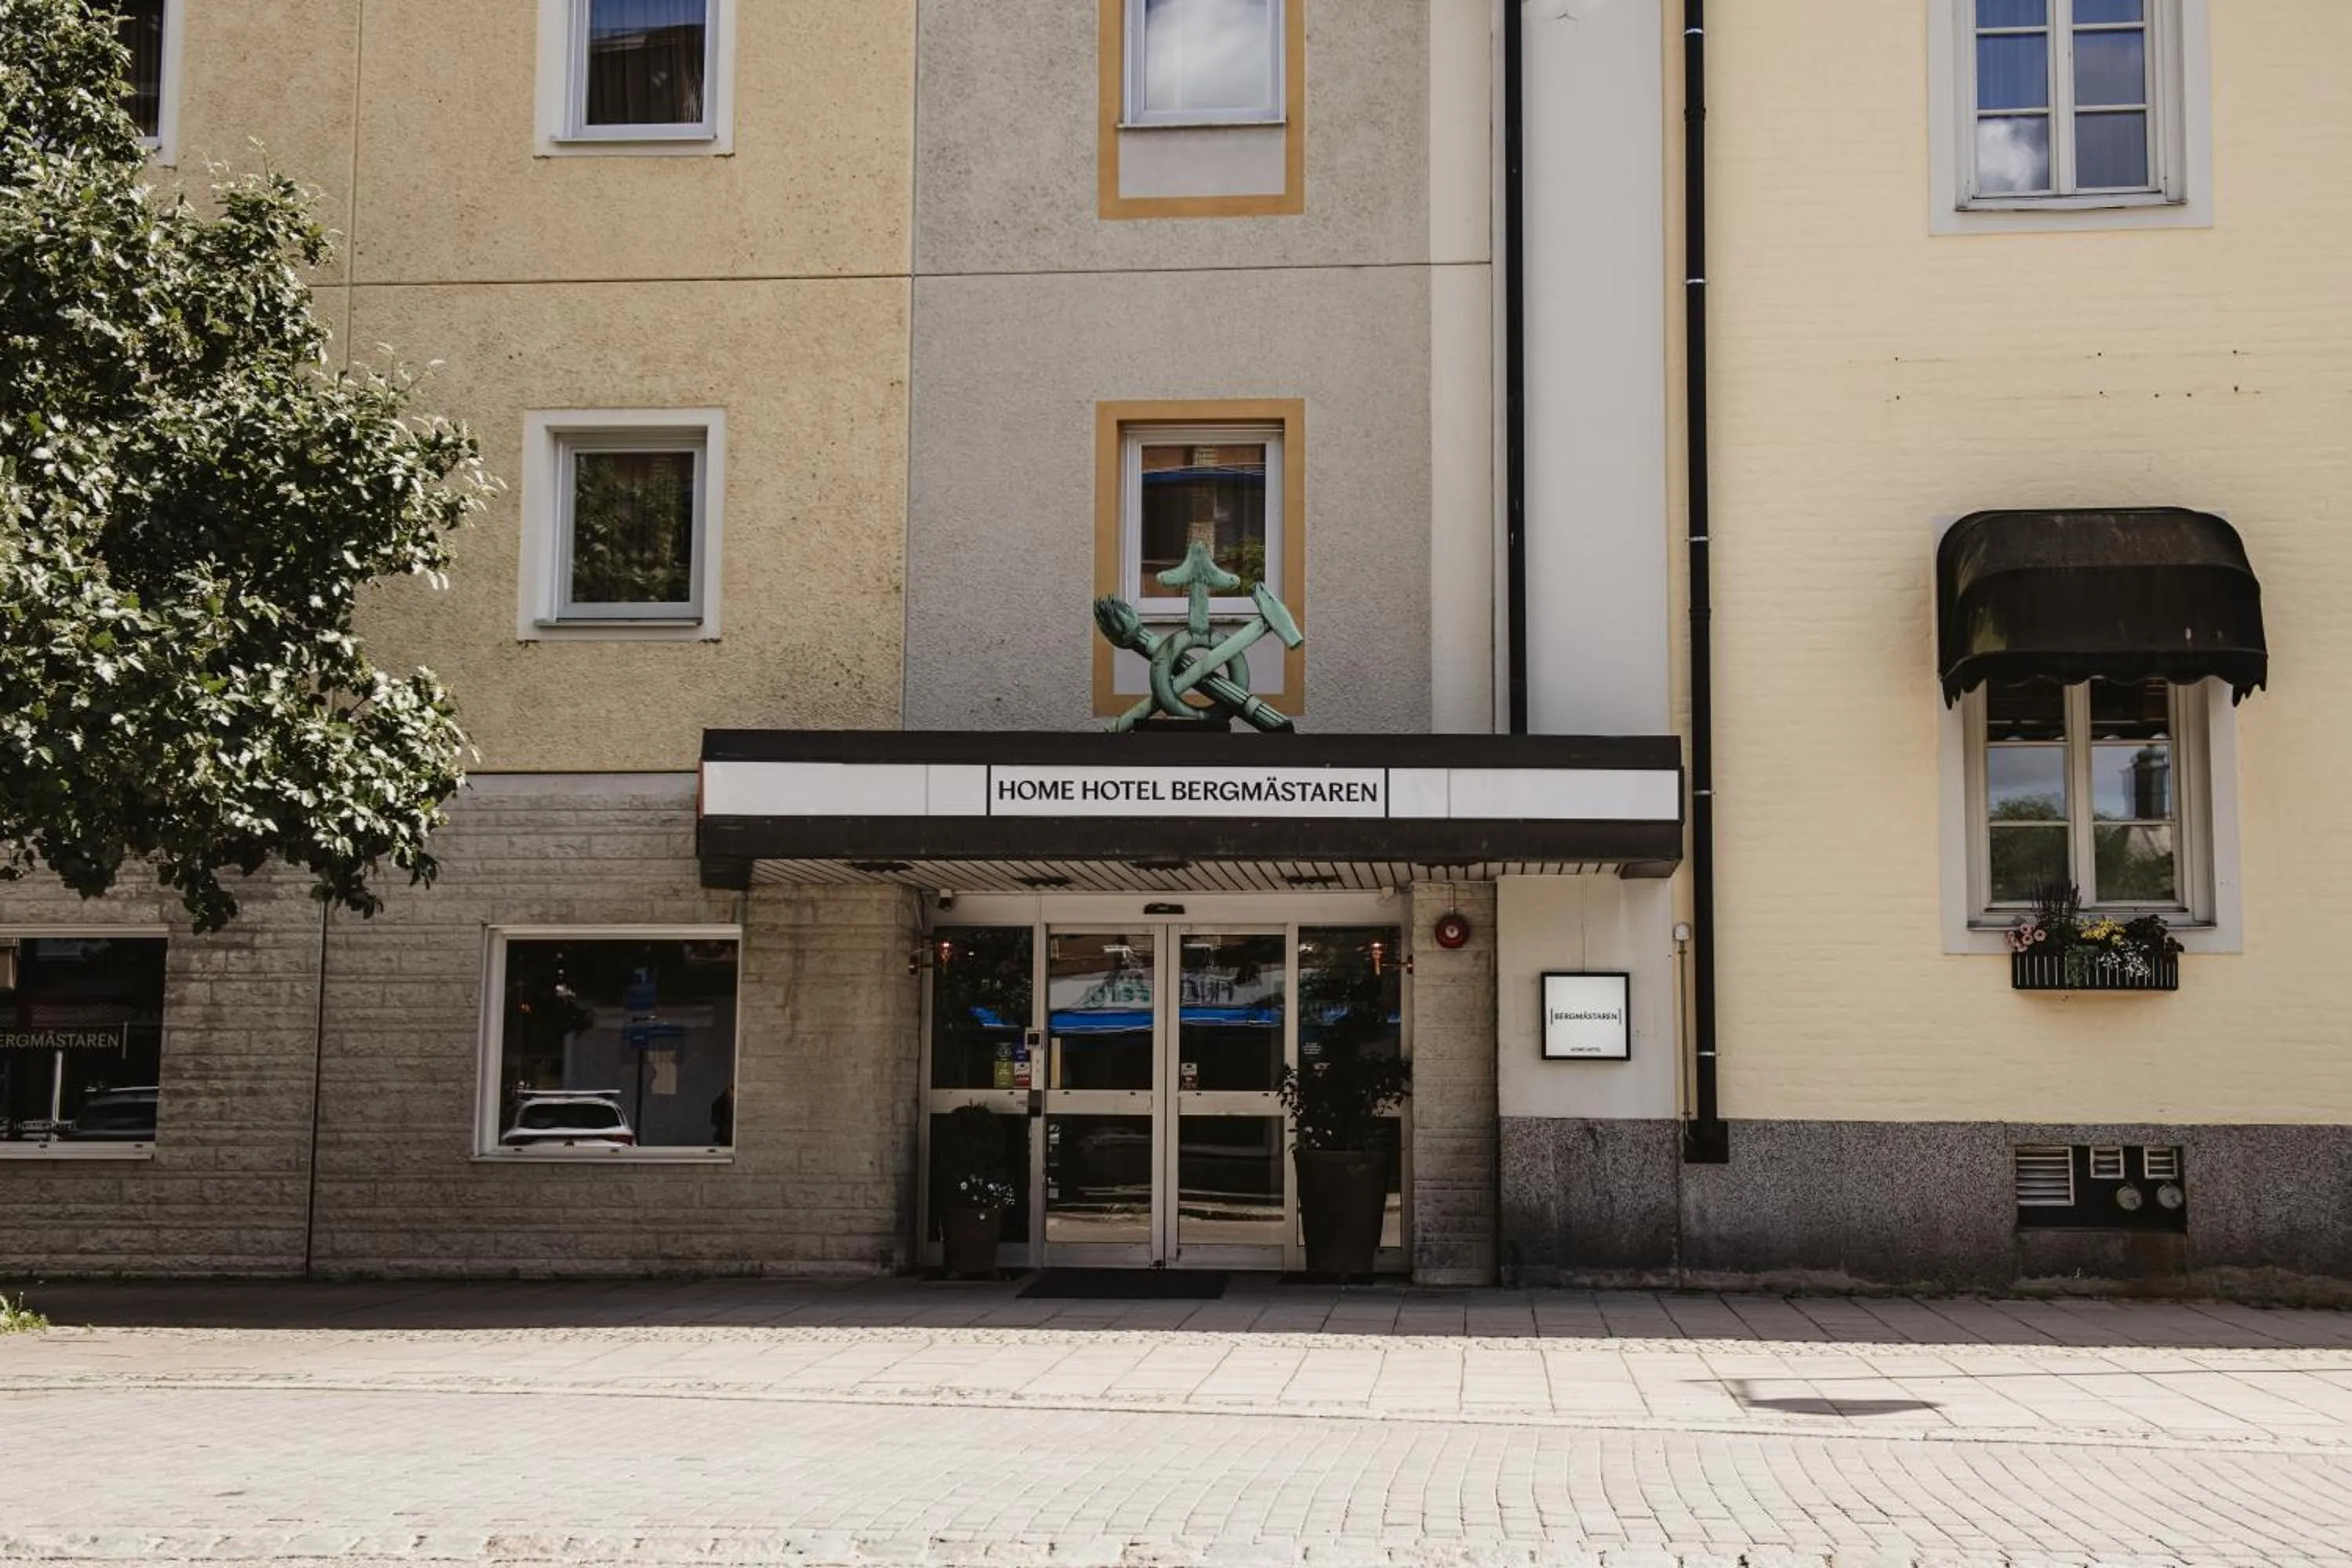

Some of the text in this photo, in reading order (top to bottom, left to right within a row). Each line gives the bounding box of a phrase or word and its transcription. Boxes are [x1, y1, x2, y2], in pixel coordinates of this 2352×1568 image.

[998, 777, 1377, 802] HOME HOTEL BERGMÄSTAREN
[1554, 1011, 1617, 1020] BERGMÄSTAREN
